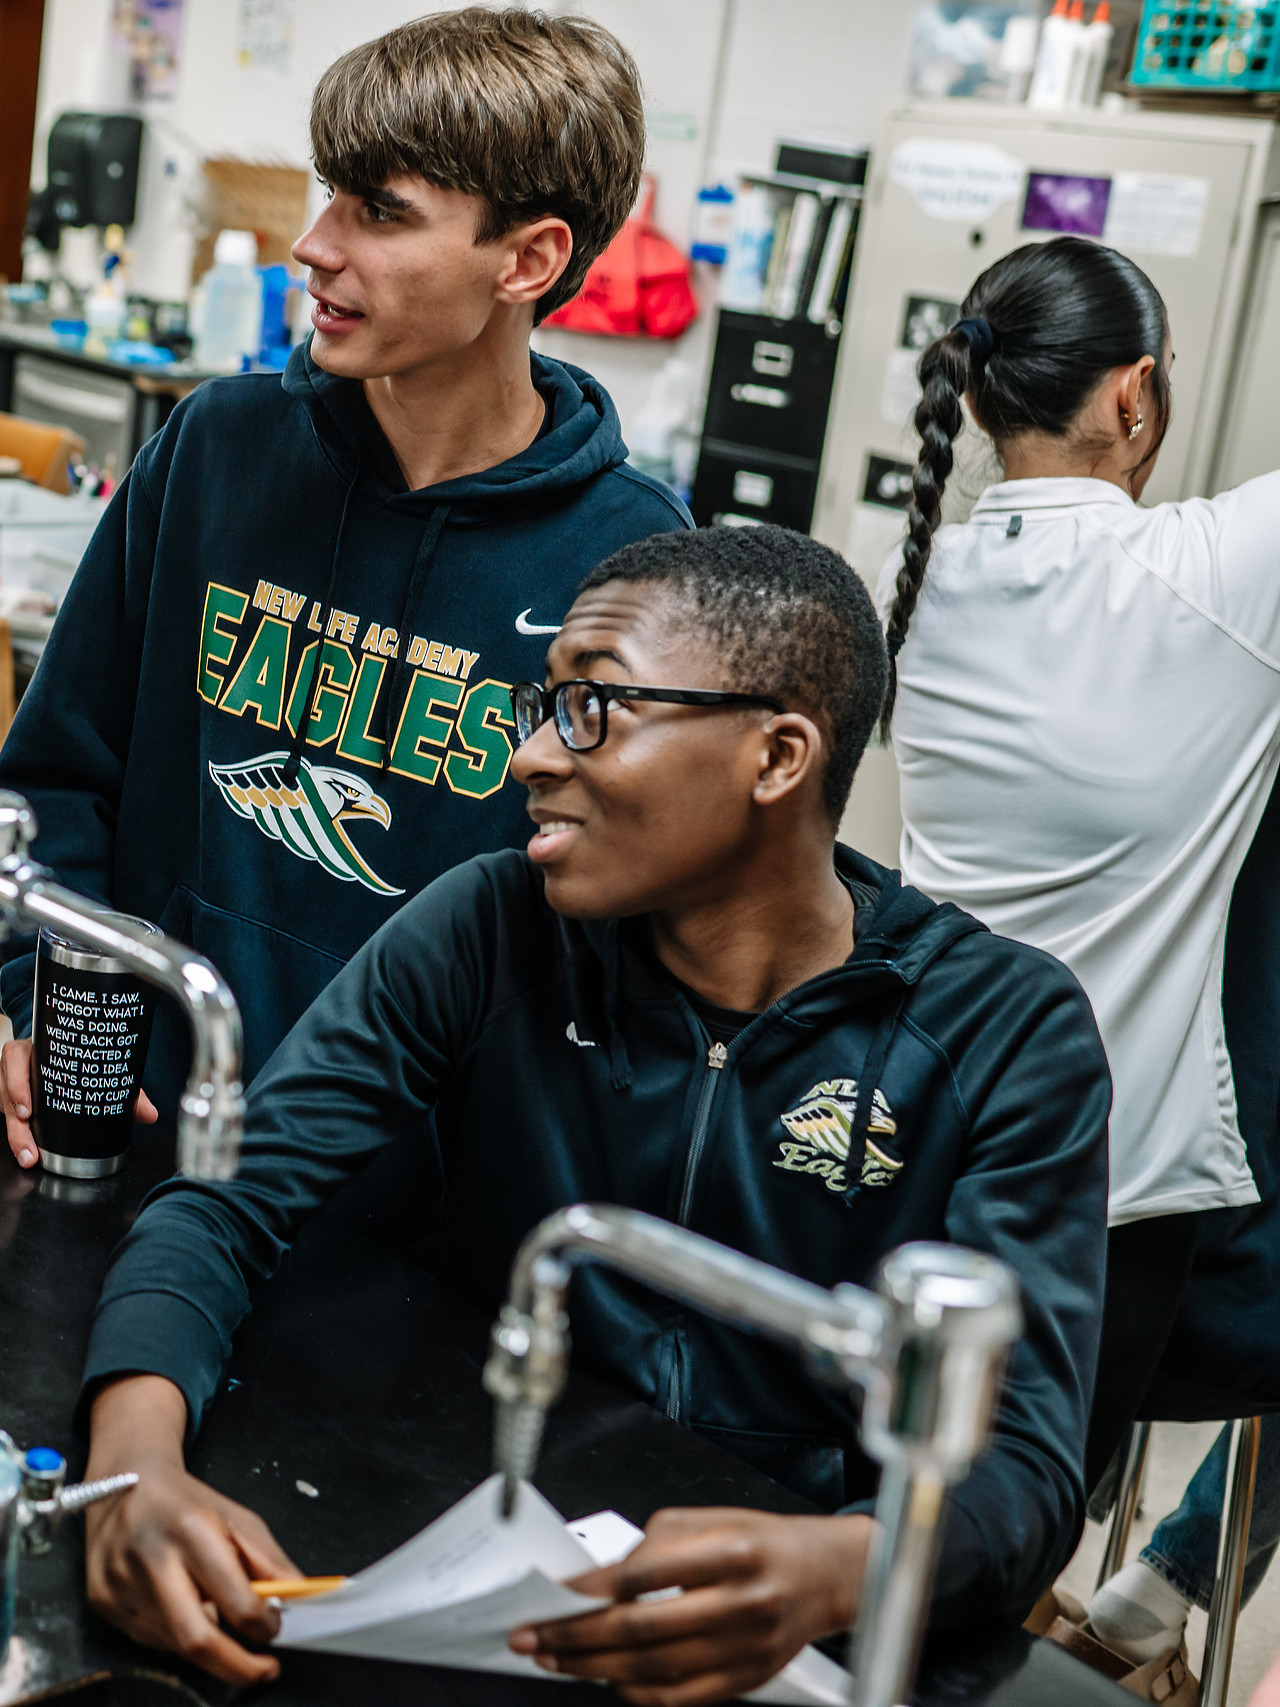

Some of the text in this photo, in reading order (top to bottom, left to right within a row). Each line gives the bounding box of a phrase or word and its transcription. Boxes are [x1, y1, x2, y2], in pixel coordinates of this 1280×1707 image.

[252, 579, 307, 622] NEW
[307, 601, 360, 645] LFE
[196, 581, 518, 800] EAGLES
[53, 982, 57, 994] I
[60, 986, 98, 1004] CAME.
[102, 993, 108, 1004] I
[46, 994, 144, 1019] I FORGOT WHAT I
[57, 1013, 129, 1033] WAS DOING.
[46, 1024, 138, 1047] WENT BACK GOT
[50, 1039, 132, 1061] DISTRACTED &
[49, 1054, 129, 1075] HAVE NO IDEA
[44, 1080, 130, 1102] IS THIS MY CUP?
[81, 1076, 119, 1089] GOING
[46, 1095, 124, 1116] I HAVE TO PEE.
